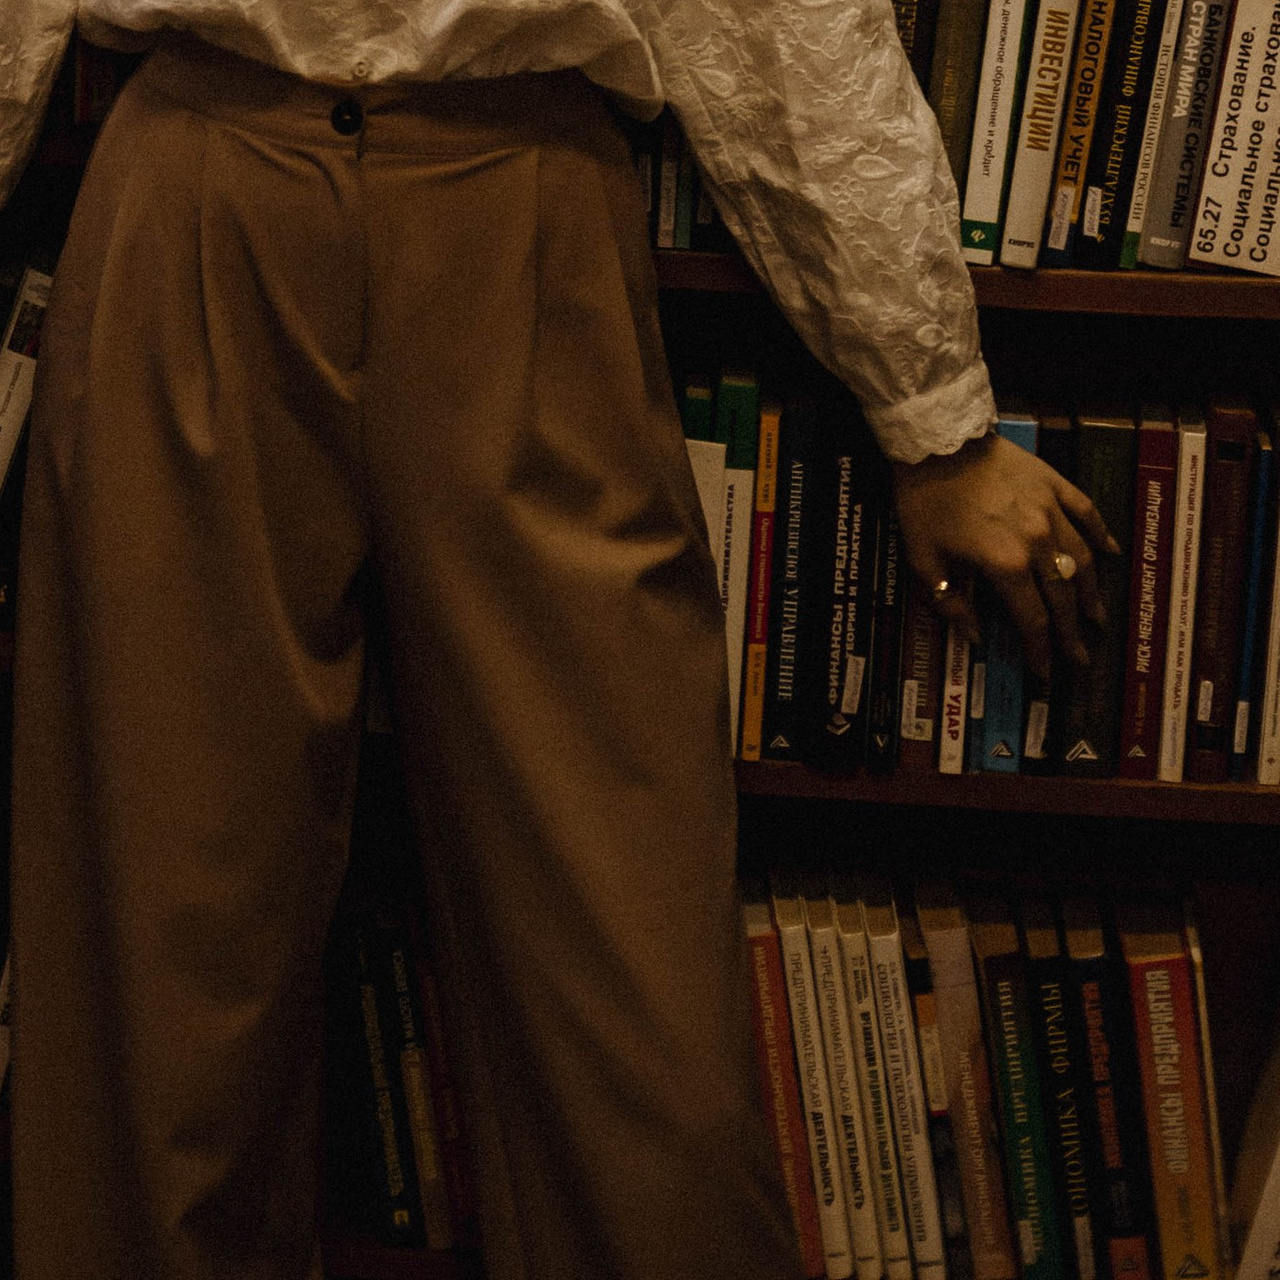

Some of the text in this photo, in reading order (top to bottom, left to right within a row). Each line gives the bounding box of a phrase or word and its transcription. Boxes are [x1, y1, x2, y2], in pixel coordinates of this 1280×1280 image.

[1025, 9, 1071, 152] ИНВЕСТИЦИИ
[1062, 0, 1108, 185] НАЛОГОВЫЙ УЧЕТ
[1170, 4, 1223, 228] БАНКОВСКИЕ СИСТЕМЫ
[1171, 0, 1205, 118] СТРАН МИРА
[1196, 26, 1257, 254] 65.27 Страхование.
[1224, 119, 1266, 258] Социальное
[1136, 479, 1162, 674] РИСК-МЕНЕДЖМЕНТ ОРГАНИЗАЦИИ
